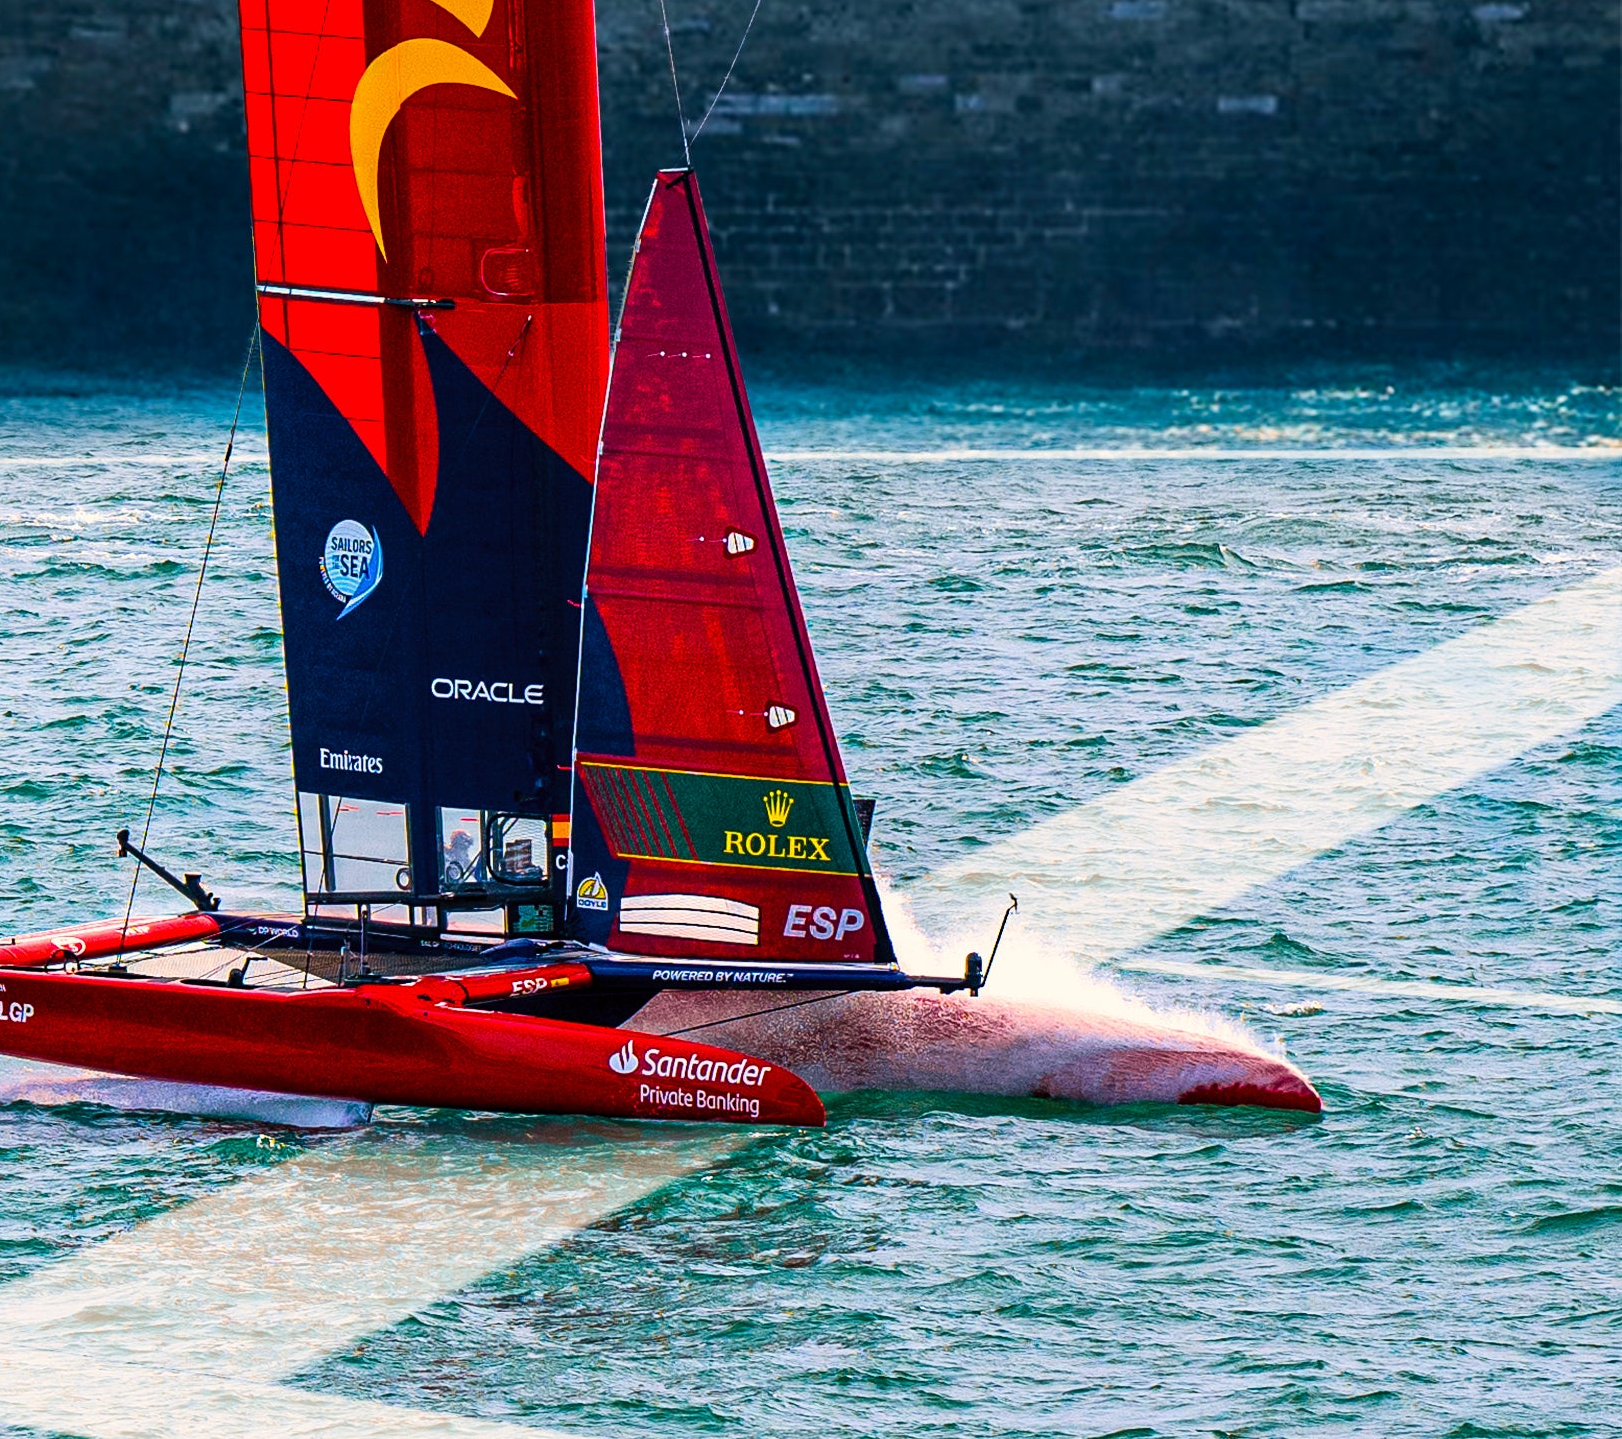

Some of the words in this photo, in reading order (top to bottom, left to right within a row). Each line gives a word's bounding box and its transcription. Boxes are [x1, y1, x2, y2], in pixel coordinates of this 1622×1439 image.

[331, 537, 372, 554] SAILORS
[340, 554, 370, 579] SEA
[431, 678, 544, 704] ORACLE
[320, 748, 383, 774] Emirates
[723, 830, 830, 862] ROLEX
[577, 899, 607, 909] DOYLE
[783, 905, 865, 941] ESP
[512, 978, 547, 995] ESP
[653, 971, 713, 982] POWERED
[716, 971, 732, 982] BY
[642, 1049, 771, 1086] Santander
[640, 1084, 692, 1107] Private
[696, 1090, 759, 1118] Banking
